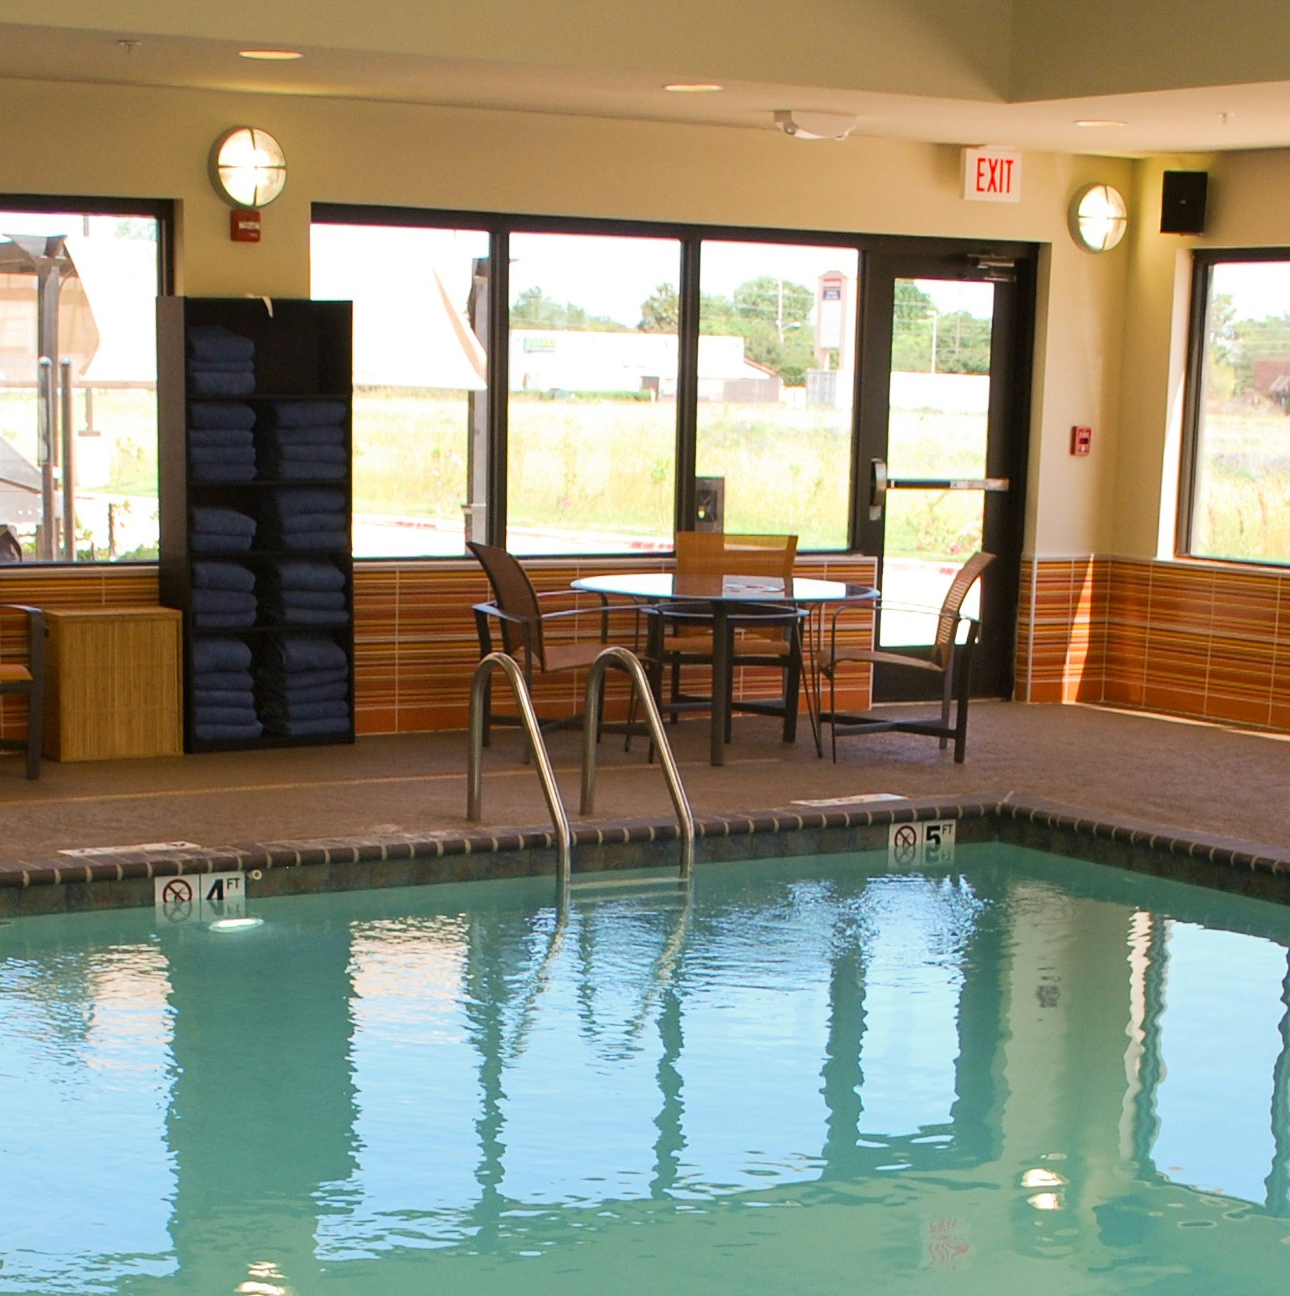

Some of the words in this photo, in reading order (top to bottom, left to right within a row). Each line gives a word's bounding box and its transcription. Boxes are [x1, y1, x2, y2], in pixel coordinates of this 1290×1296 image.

[976, 158, 1013, 193] EXIT
[926, 825, 941, 845] 5
[942, 824, 953, 834] FT
[226, 878, 240, 890] FT
